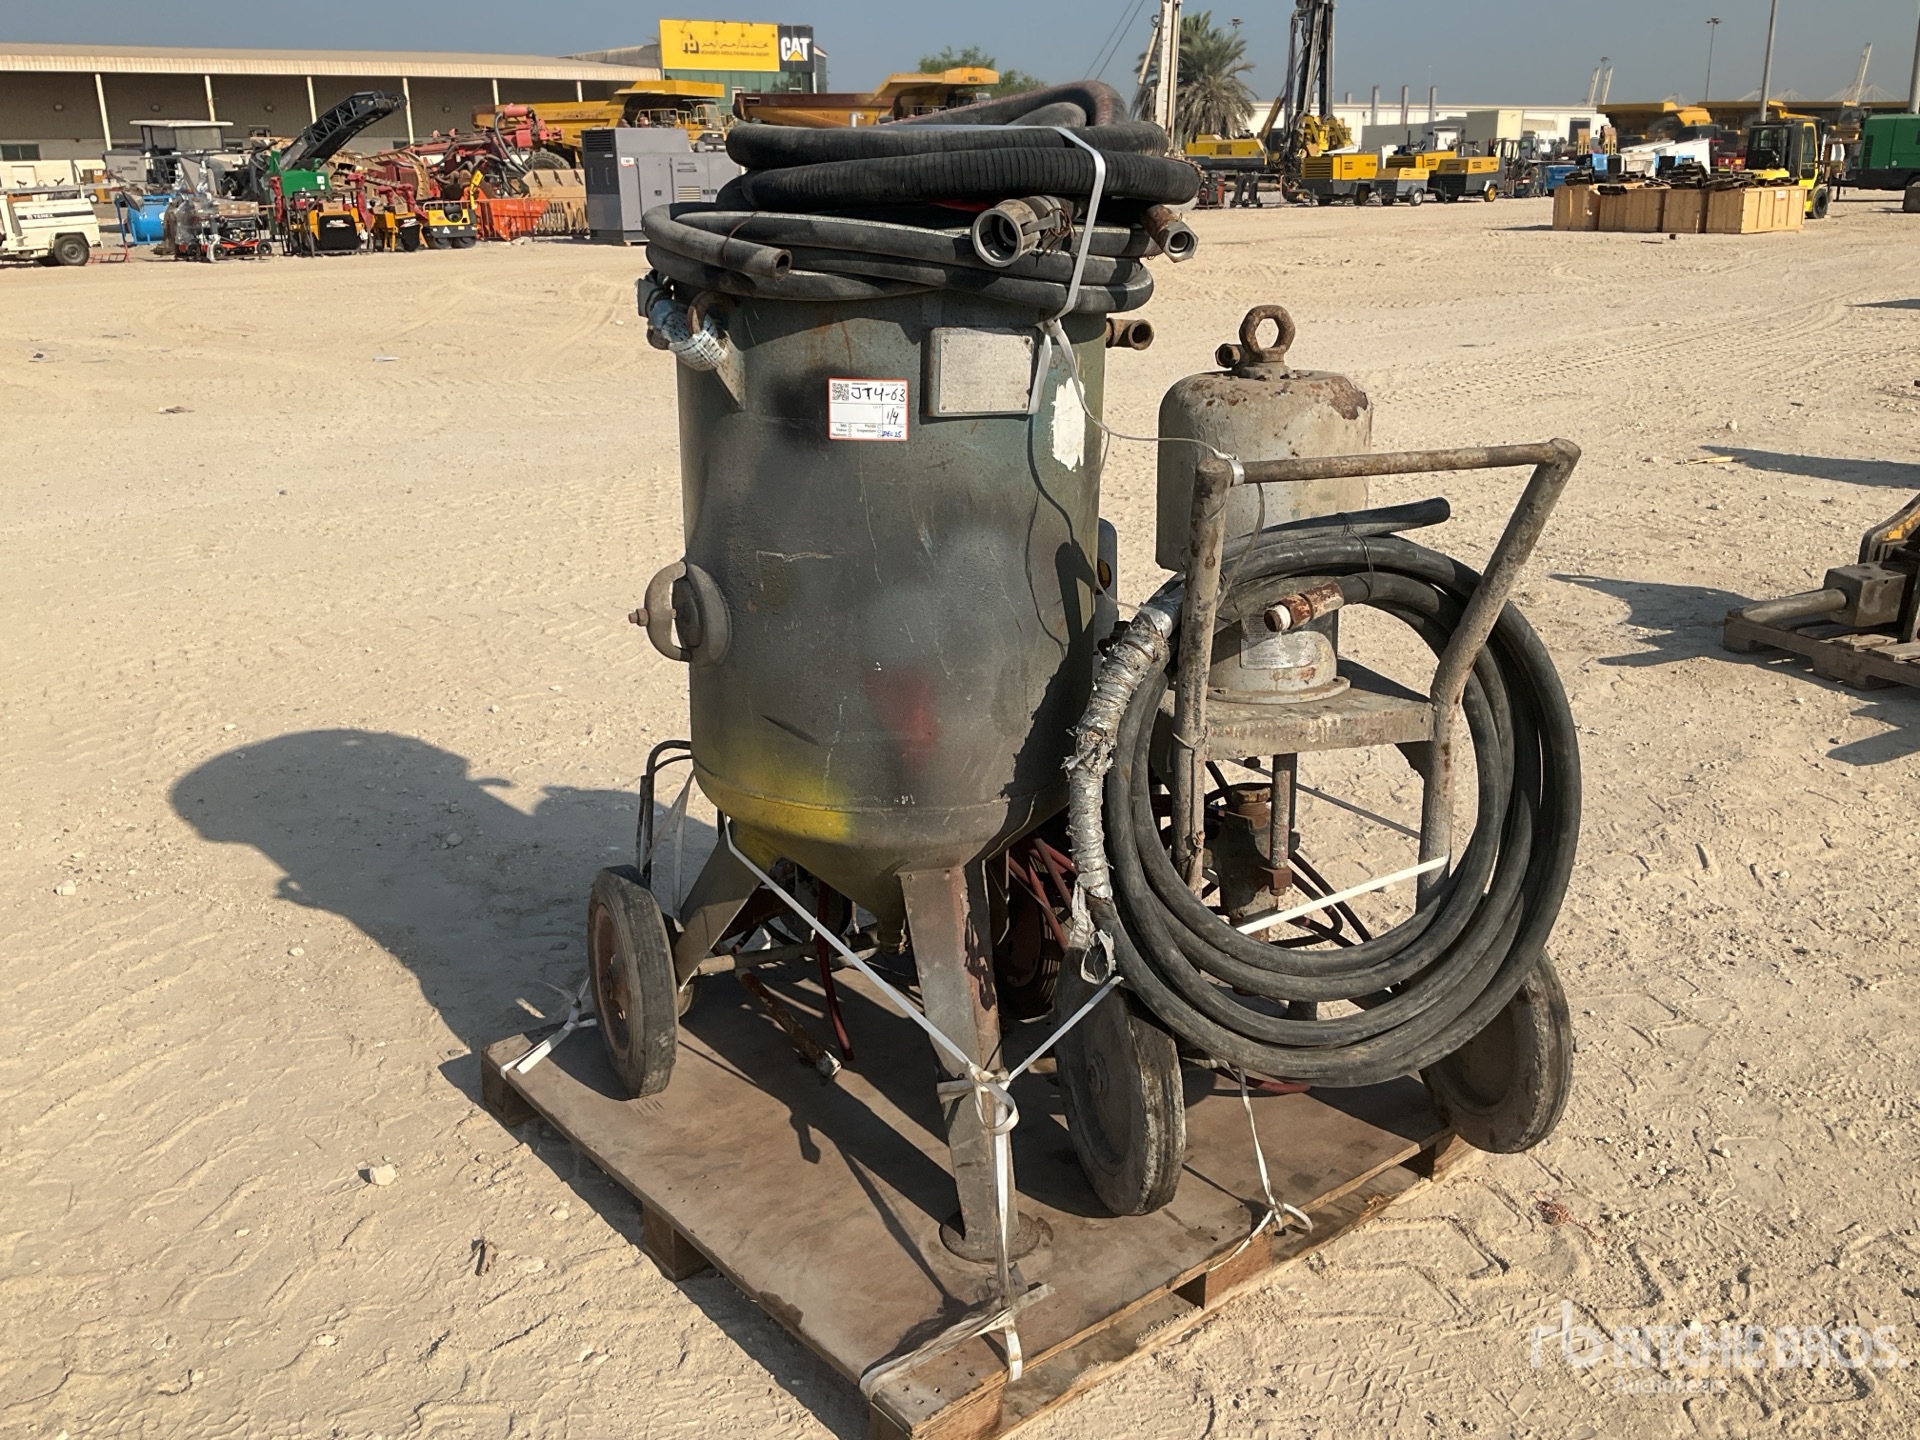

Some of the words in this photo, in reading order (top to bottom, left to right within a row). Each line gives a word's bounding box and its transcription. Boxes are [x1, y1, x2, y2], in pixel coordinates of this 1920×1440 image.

[781, 37, 811, 61] CAT
[851, 387, 905, 402] JT4-63
[886, 408, 899, 425] 1/4
